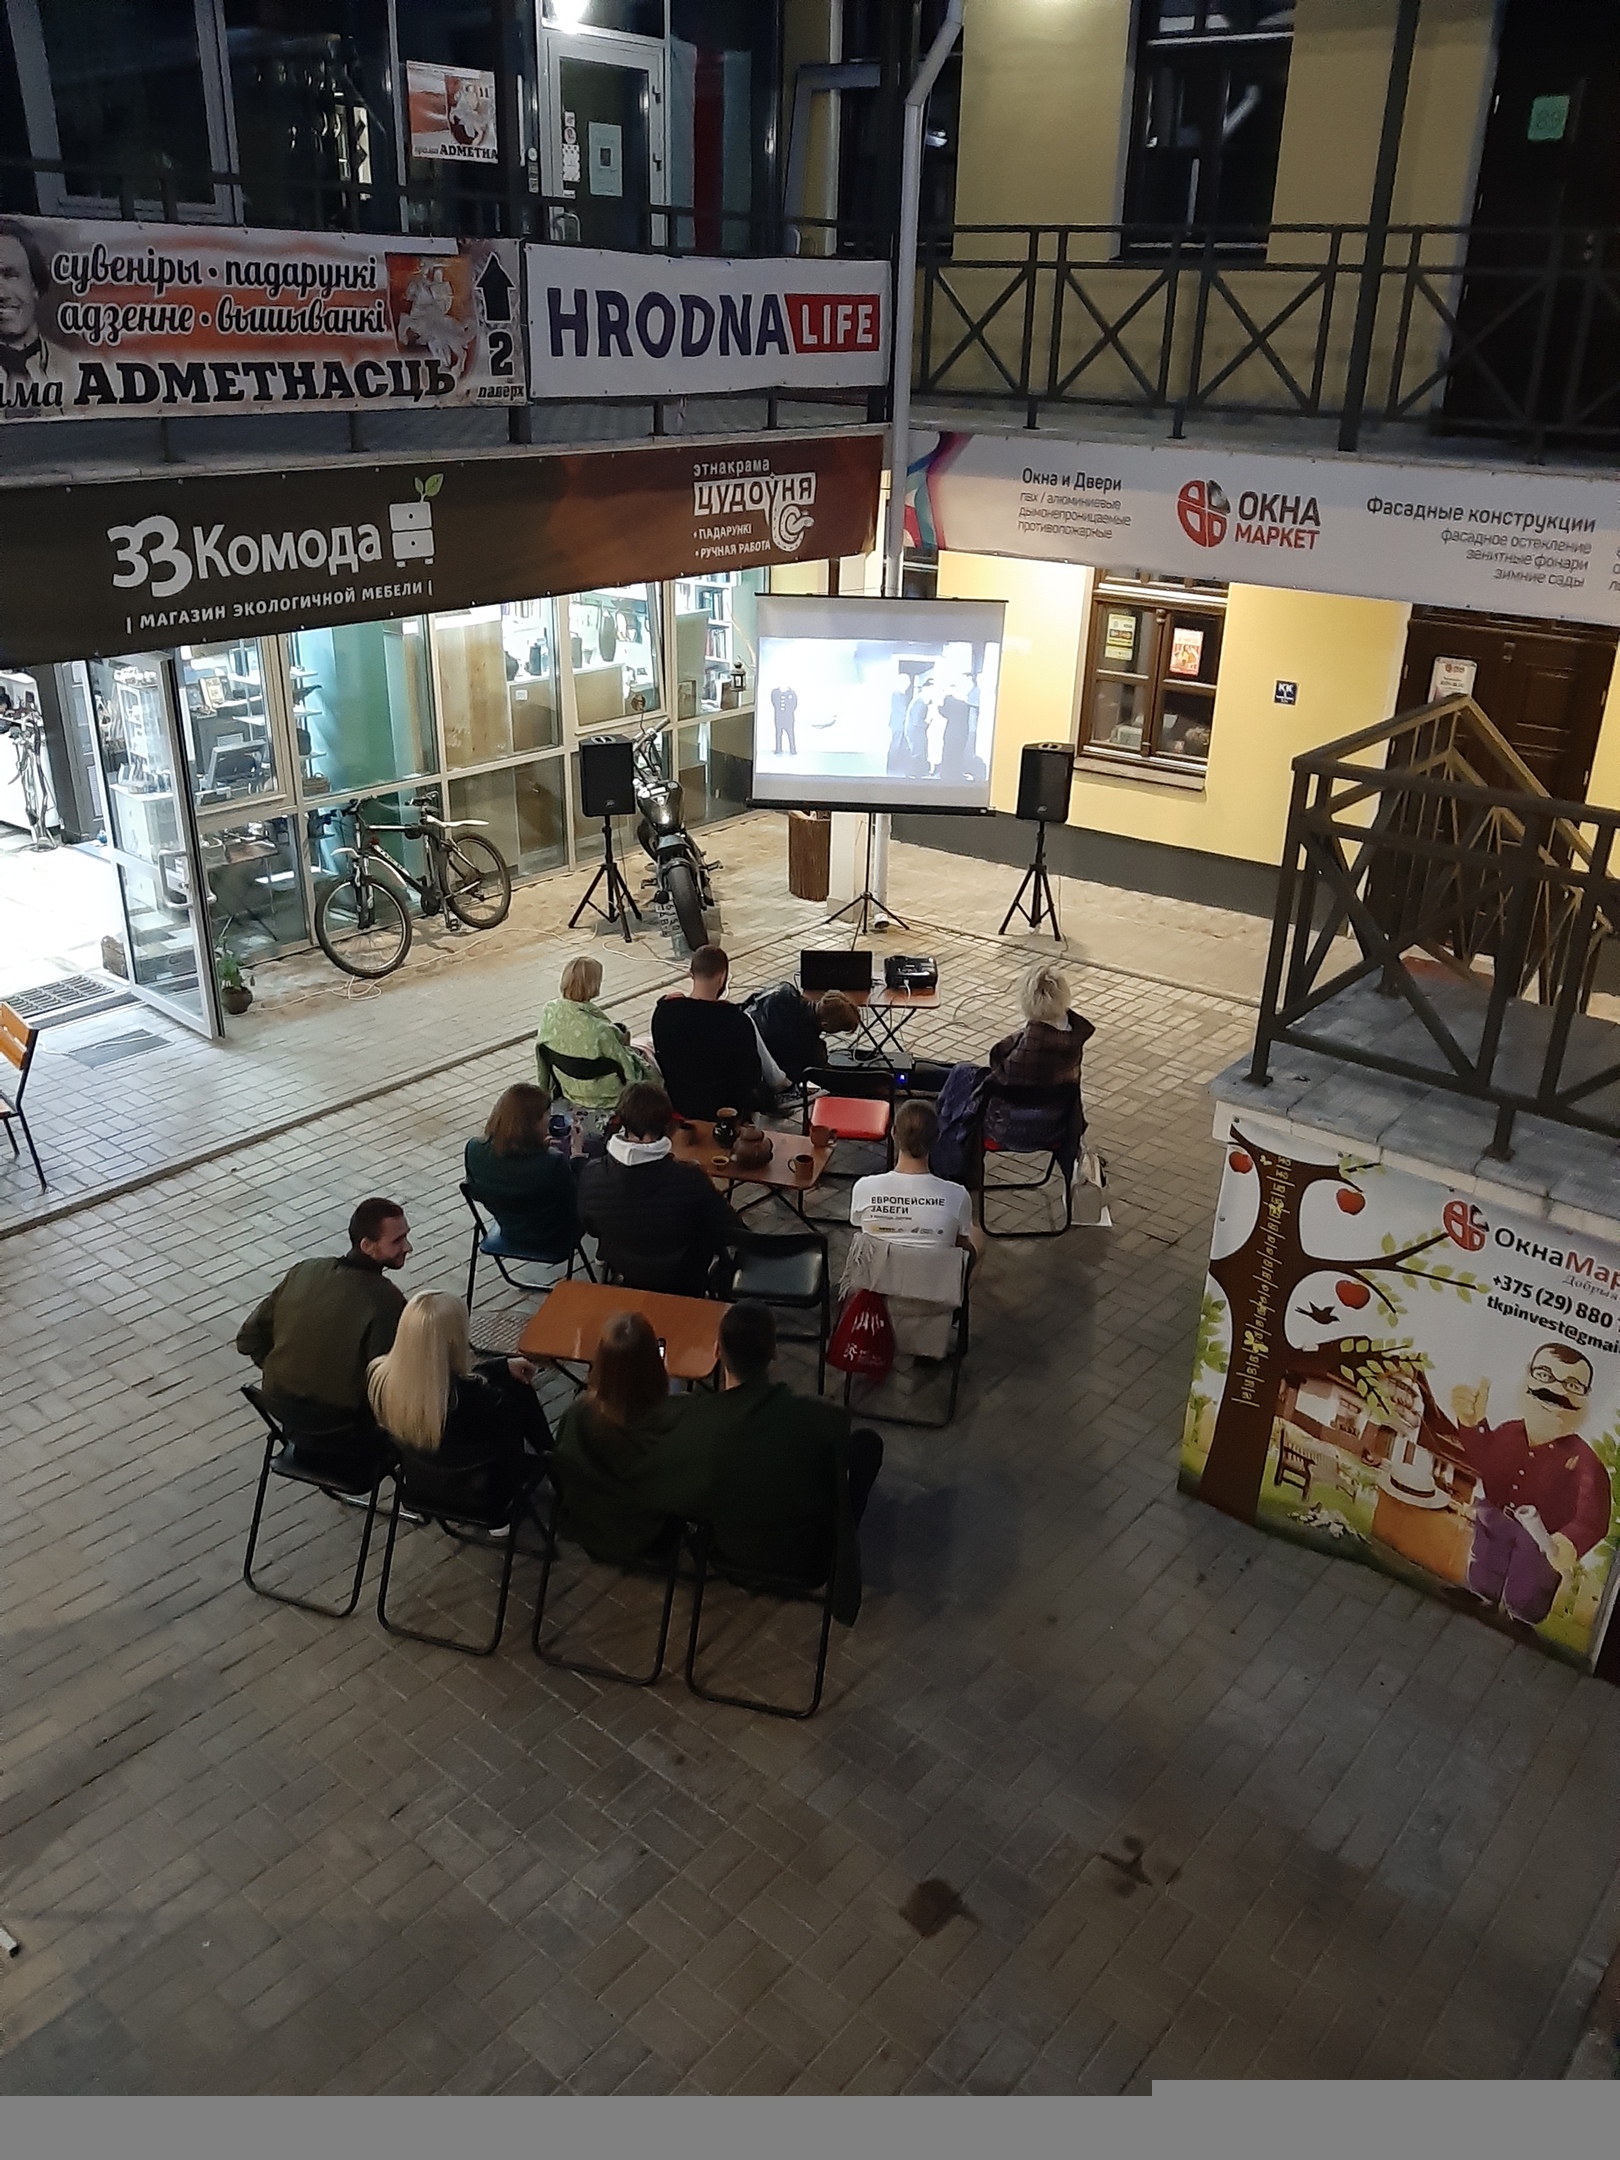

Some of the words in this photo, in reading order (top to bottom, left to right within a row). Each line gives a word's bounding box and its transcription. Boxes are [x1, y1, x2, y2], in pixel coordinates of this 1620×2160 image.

[54, 244, 202, 295] сувеніры
[225, 257, 376, 297] падарункі
[60, 304, 193, 343] адзенне
[217, 297, 385, 333] вышыванкі
[547, 287, 790, 358] HRODNA
[801, 303, 873, 345] LIFE
[489, 331, 513, 376] 2
[0, 381, 63, 409] ма
[693, 459, 770, 476] этнакрама
[1022, 467, 1058, 486] Окна
[1061, 474, 1071, 487] и
[1073, 471, 1122, 494] Двери
[1238, 491, 1321, 526] ОКНА
[1366, 496, 1464, 521] Фасадные
[1468, 507, 1597, 534] конструкции
[699, 523, 752, 540] ПАДАРУНКІ
[1234, 522, 1320, 549] МАРКЕТ
[1441, 528, 1507, 545] фасадное
[1511, 536, 1592, 555] остекление
[193, 523, 382, 579] Комода
[700, 543, 737, 558] РУЧНАЯ
[740, 540, 771, 553] РАБОТА
[1466, 549, 1532, 565] зенитные
[1534, 554, 1589, 573] фонари
[1493, 568, 1546, 584] зимние
[1548, 573, 1585, 588] сады
[140, 605, 226, 629] МАГАЗИН
[233, 587, 355, 617] ЭКОЛОГИЧНОЙ
[362, 581, 422, 600] МЕБЕЛИ
[870, 1205, 909, 1214] ЗАБЕГИ
[871, 1196, 945, 1206] ЕВРОПЕЙСКИЕ
[1493, 1275, 1534, 1299] +375
[1535, 1287, 1573, 1315] (29)
[1575, 1302, 1613, 1328] 880
[1487, 1295, 1620, 1354] tkpinvest@gmai
